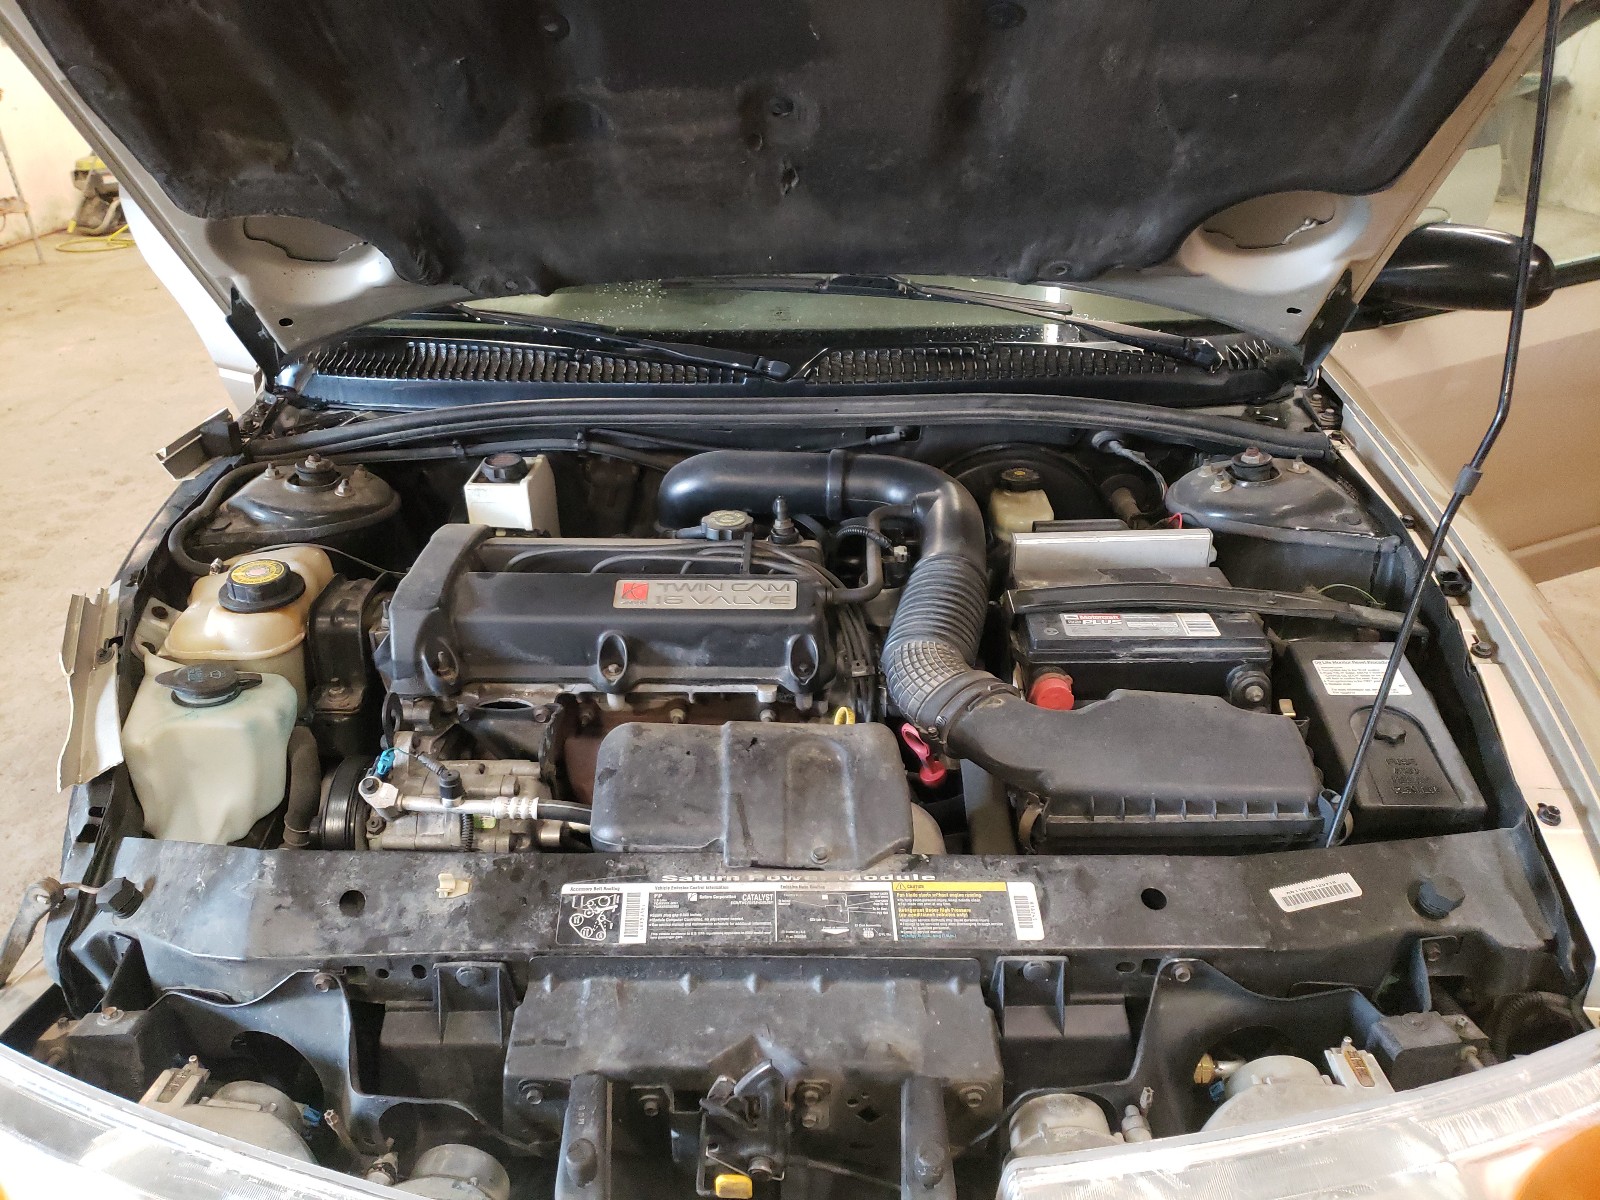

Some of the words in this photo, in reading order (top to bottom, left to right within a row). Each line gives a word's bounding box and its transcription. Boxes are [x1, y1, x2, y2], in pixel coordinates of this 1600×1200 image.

[656, 582, 724, 592] TWIN
[731, 582, 791, 592] CAM
[655, 595, 683, 605] 16
[690, 595, 791, 605] VALVE
[661, 874, 740, 882] Saturn
[742, 893, 774, 901] CATALYST
